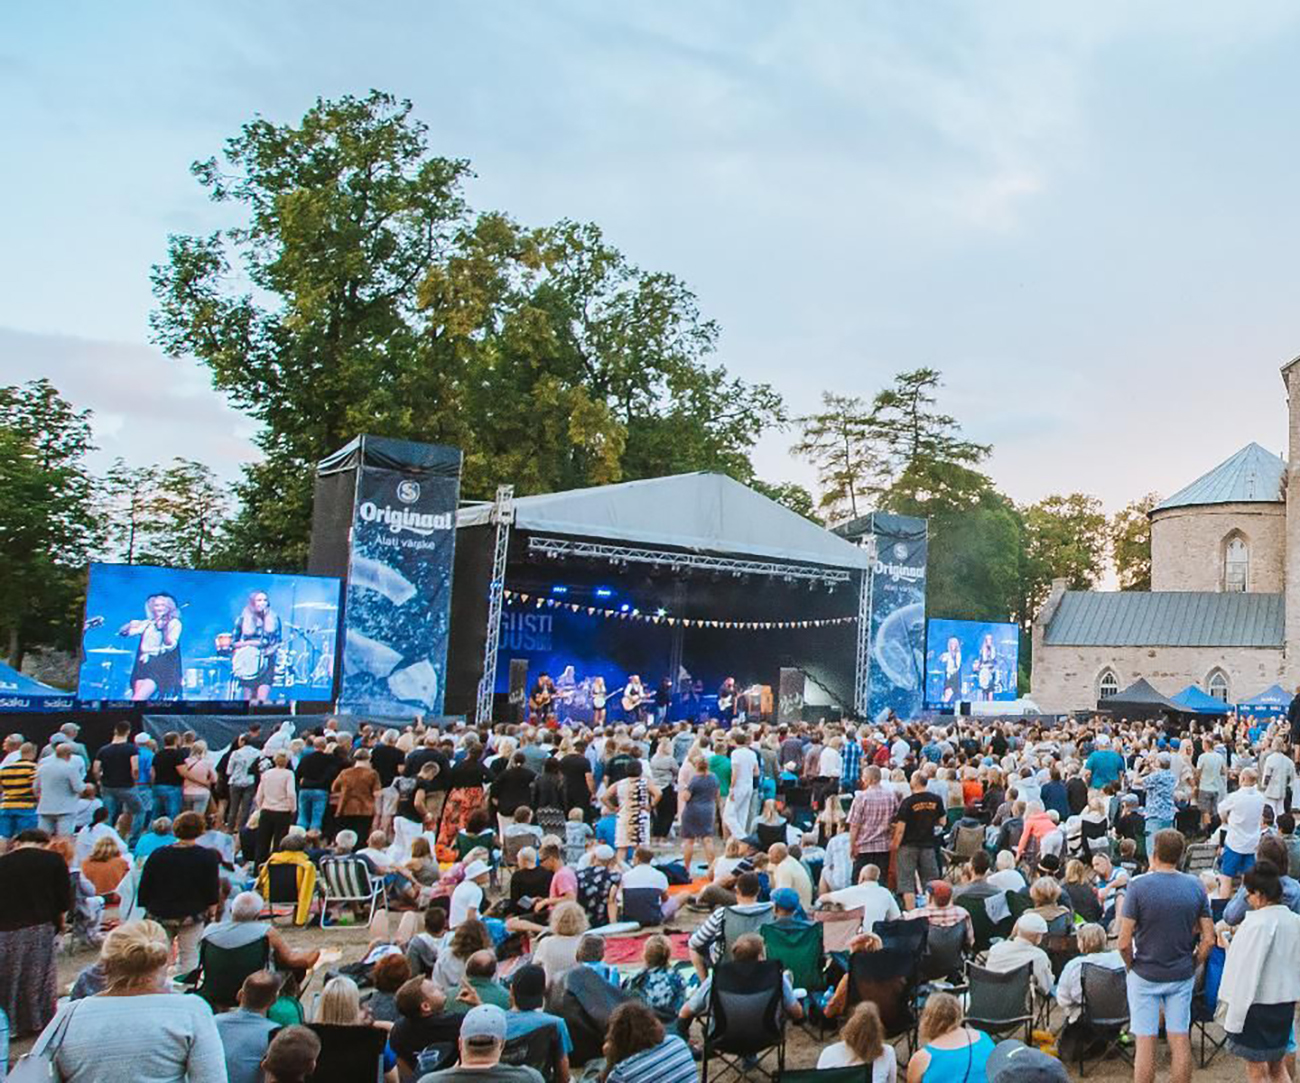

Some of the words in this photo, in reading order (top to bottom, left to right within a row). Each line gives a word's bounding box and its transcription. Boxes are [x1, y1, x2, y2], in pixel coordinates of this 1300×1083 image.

[360, 502, 452, 536] Originaal
[375, 533, 399, 547] Alati
[43, 698, 73, 708] saku
